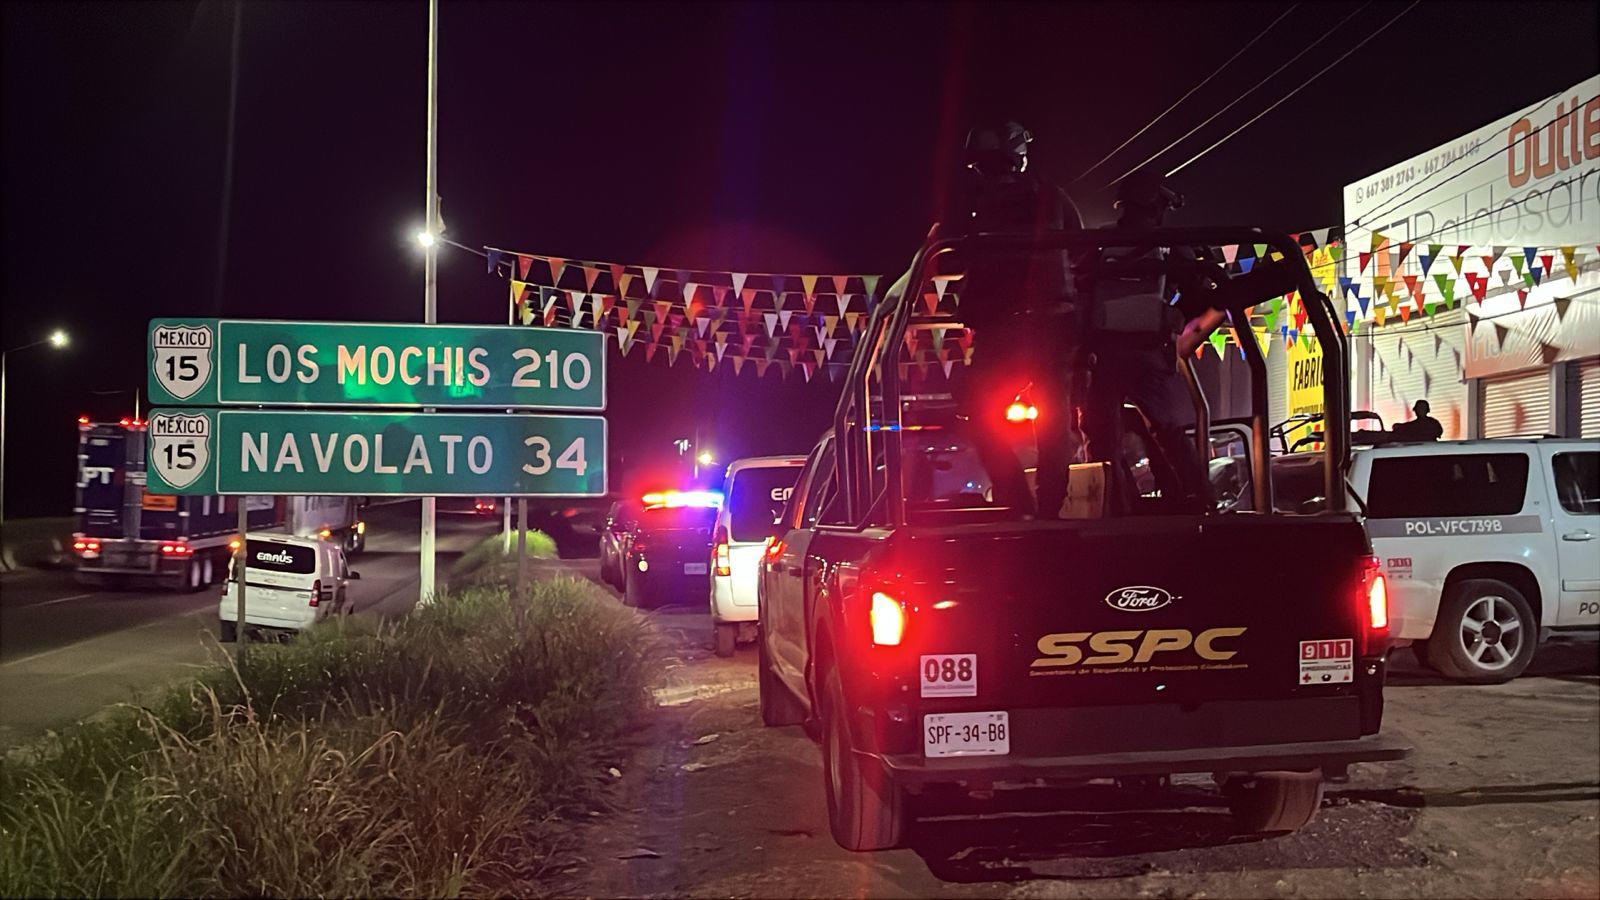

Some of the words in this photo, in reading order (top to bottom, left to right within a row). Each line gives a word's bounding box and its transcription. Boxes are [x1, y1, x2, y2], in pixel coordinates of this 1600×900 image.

[1414, 168, 1600, 271] Baldosar
[159, 332, 207, 346] MEXICO
[166, 355, 199, 381] 15
[238, 343, 320, 384] LOS
[337, 345, 491, 387] MOCHIS
[511, 348, 592, 390] 210
[157, 419, 205, 434] MEXICO
[164, 443, 197, 469] 15
[241, 432, 494, 475] NAVOLATO
[522, 436, 588, 476] 34
[1118, 589, 1160, 607] Ford
[1030, 627, 1248, 667] SSPC
[1304, 642, 1347, 658] 911
[924, 657, 973, 682] 088
[927, 723, 1006, 745] SPF-34-B8
